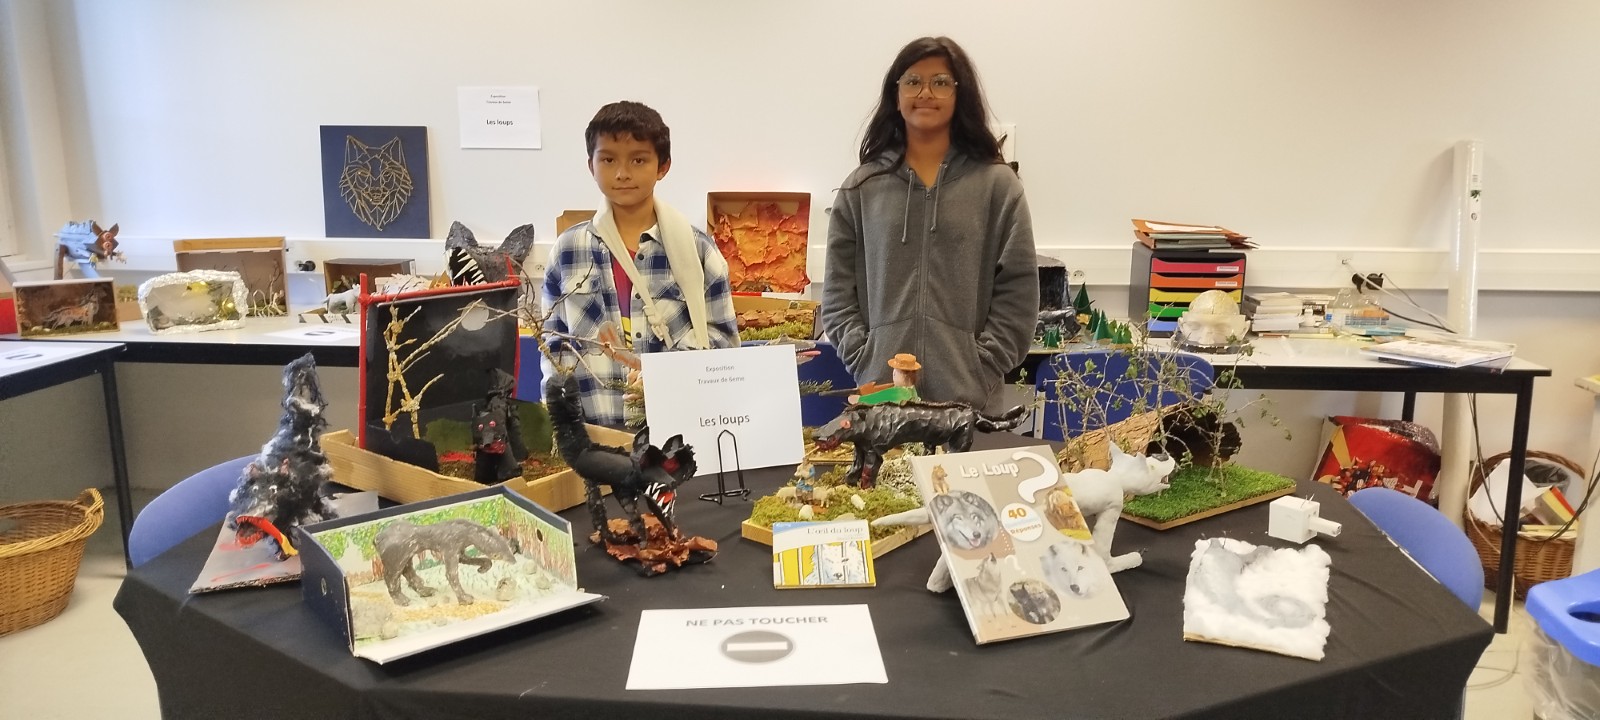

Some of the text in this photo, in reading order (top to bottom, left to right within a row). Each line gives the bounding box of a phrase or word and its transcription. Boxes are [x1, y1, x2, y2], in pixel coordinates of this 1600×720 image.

[705, 365, 735, 373] Exposition
[699, 414, 750, 428] Les loups
[959, 464, 980, 478] Le
[981, 463, 1019, 478] Loup
[1007, 507, 1027, 519] 40
[685, 616, 829, 627] NE PAS TOUCHER
